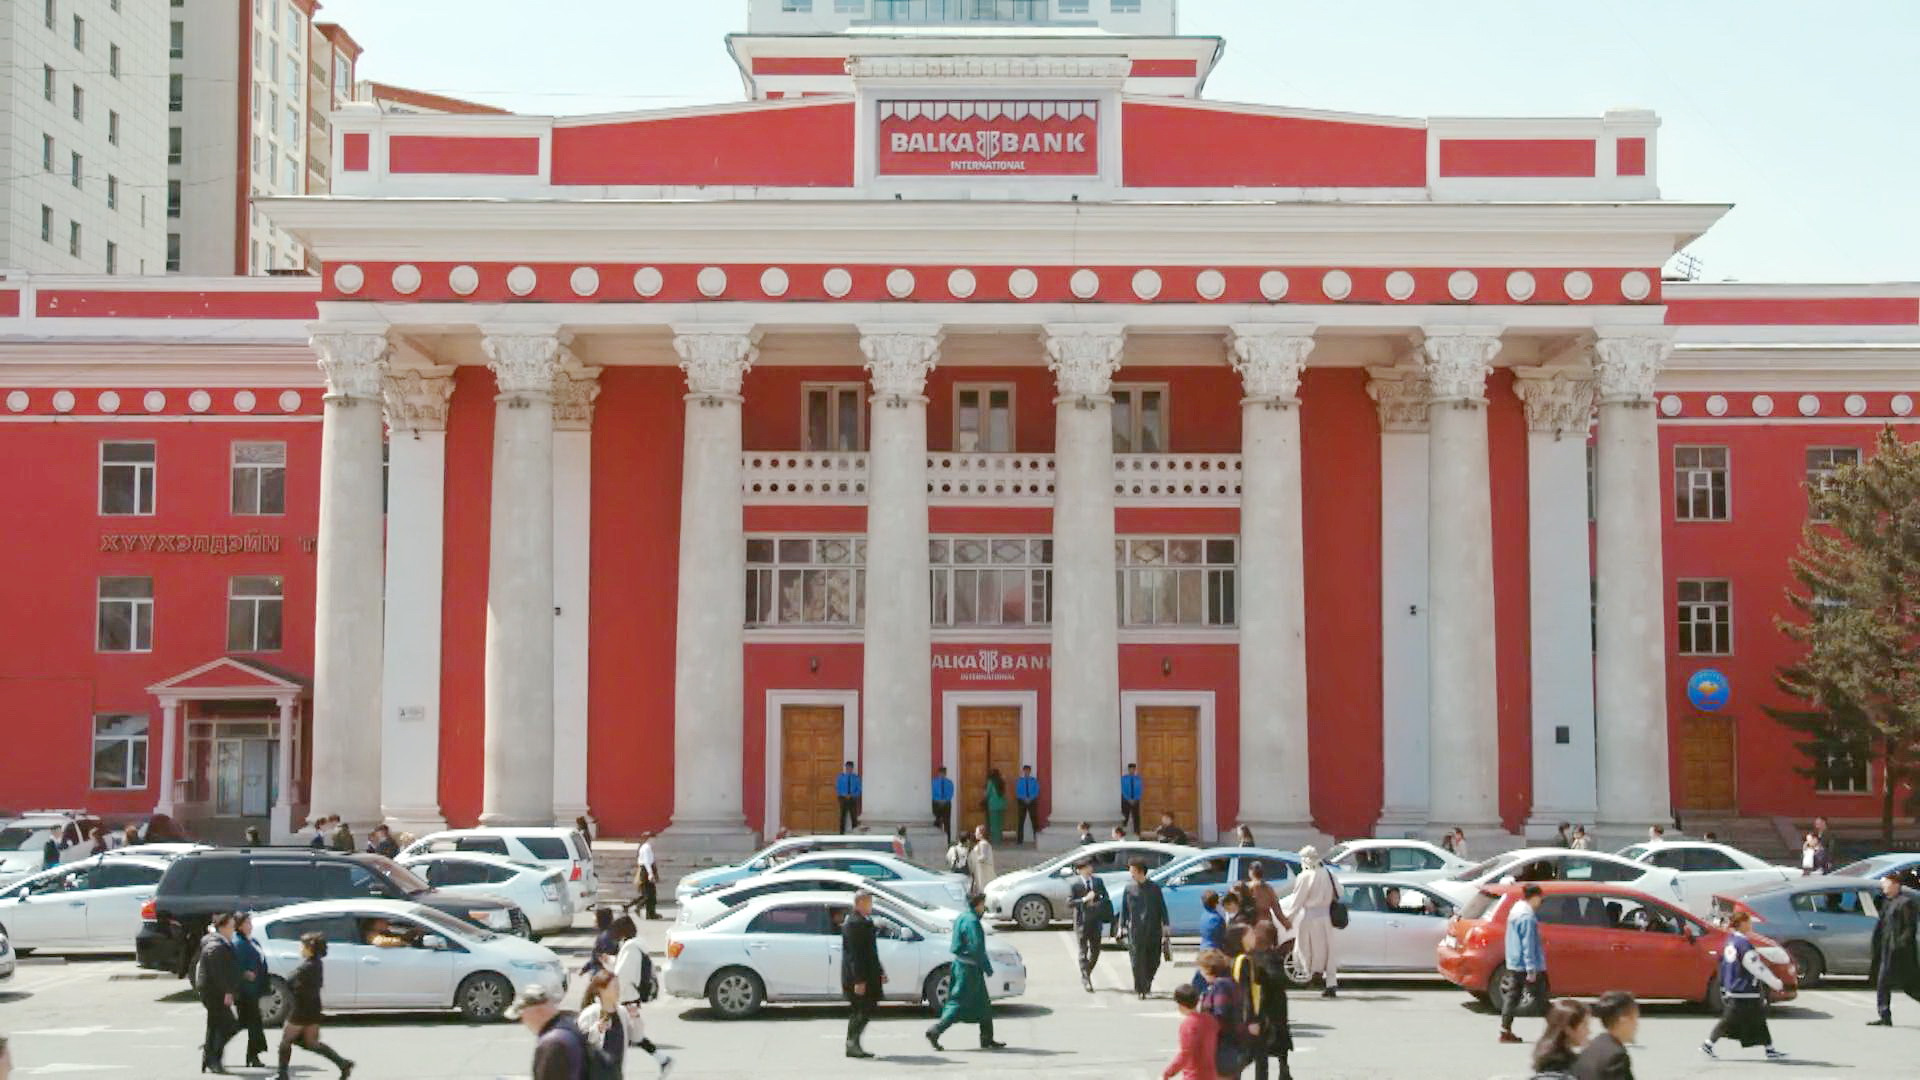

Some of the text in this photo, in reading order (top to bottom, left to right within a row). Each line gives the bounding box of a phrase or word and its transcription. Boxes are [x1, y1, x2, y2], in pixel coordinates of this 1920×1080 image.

[890, 132, 975, 153] BALKA
[1001, 132, 1086, 153] BANK
[951, 160, 1026, 171] INTERNATIONAL
[931, 655, 977, 669] ALKA
